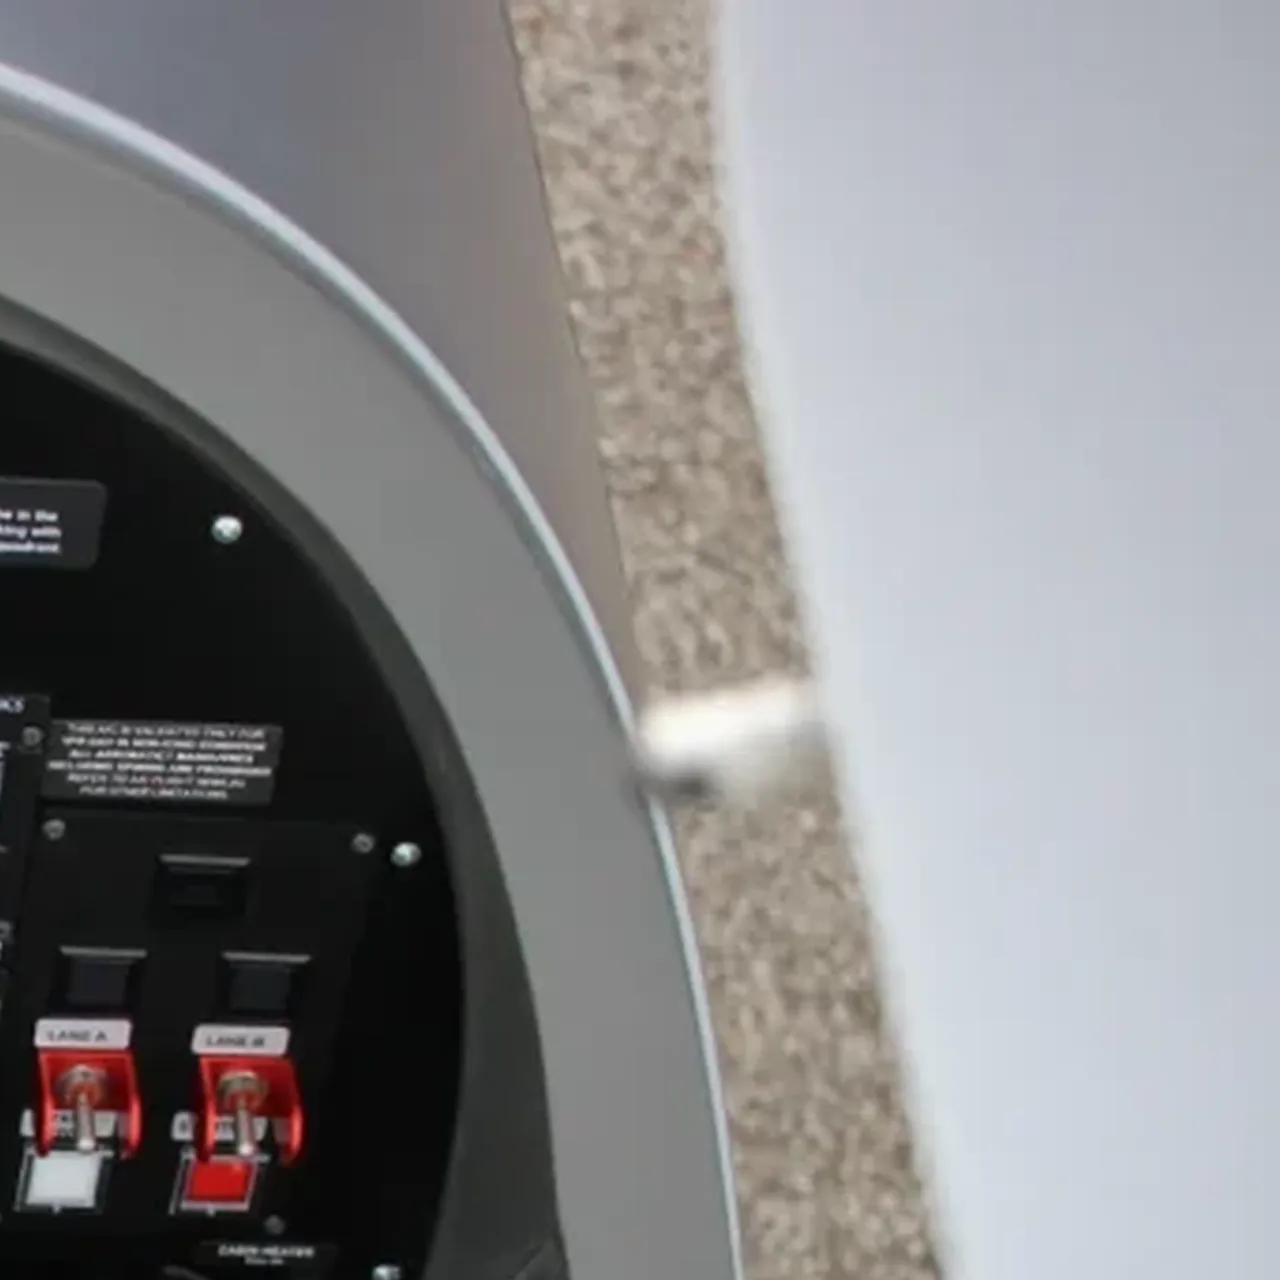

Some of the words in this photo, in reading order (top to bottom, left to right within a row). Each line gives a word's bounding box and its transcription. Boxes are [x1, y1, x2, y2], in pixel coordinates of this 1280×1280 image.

[45, 1029, 88, 1042] LANE
[94, 1030, 109, 1042] A
[205, 1035, 248, 1048] LANE
